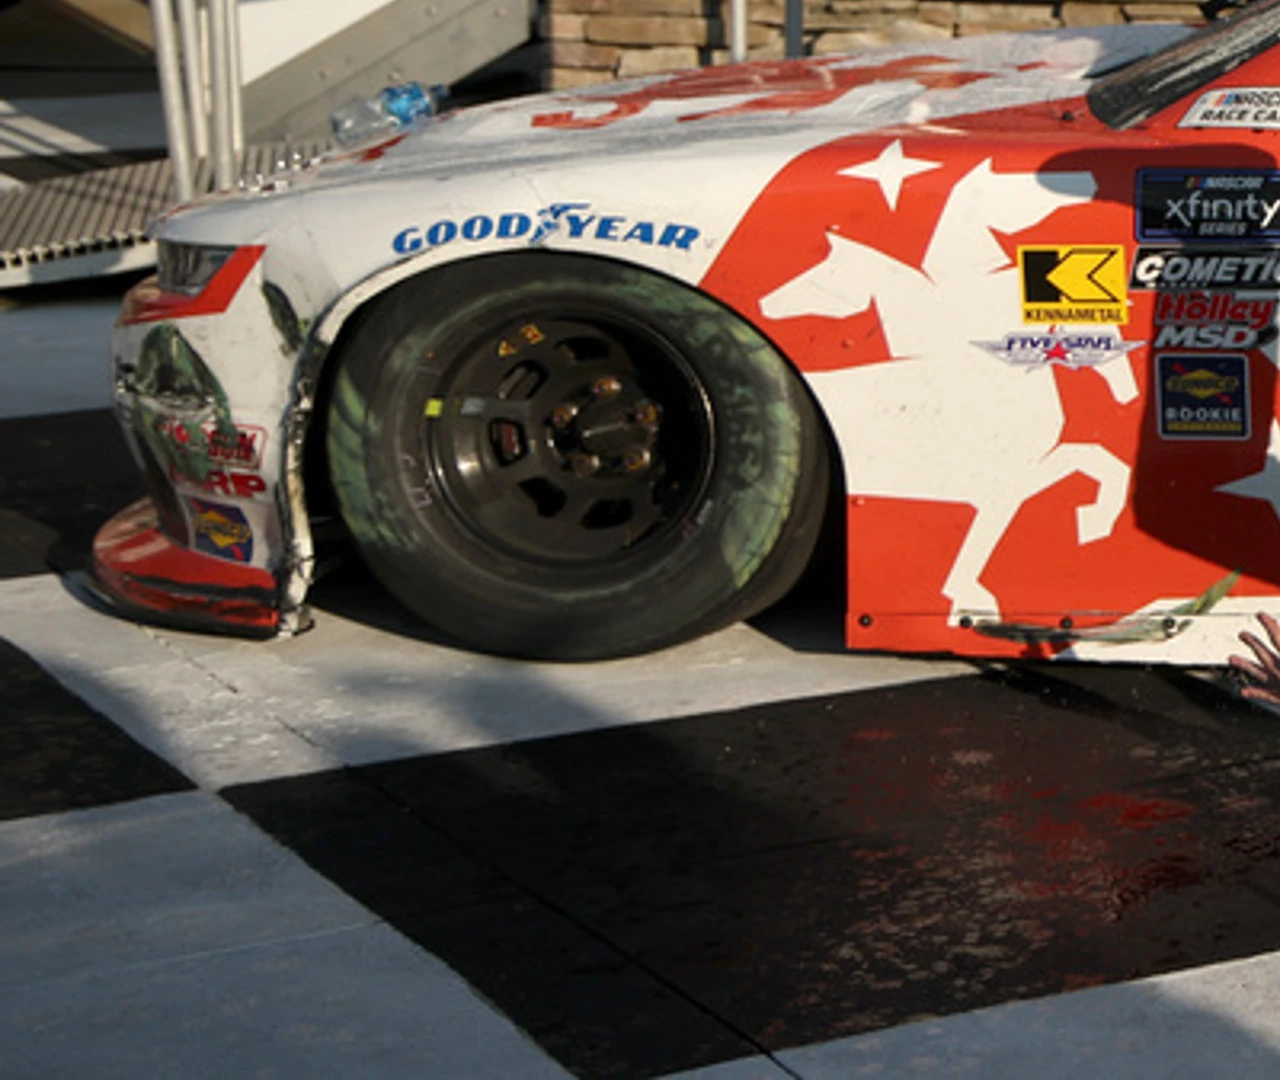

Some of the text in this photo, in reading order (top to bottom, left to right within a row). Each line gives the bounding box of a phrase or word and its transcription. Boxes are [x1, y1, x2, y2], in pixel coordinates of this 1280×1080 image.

[1200, 110, 1248, 122] RACE
[1024, 308, 1124, 323] KENNAMETAL
[1157, 291, 1275, 331] Holley
[1153, 325, 1258, 349] MSD
[1165, 406, 1242, 422] ROOKIE
